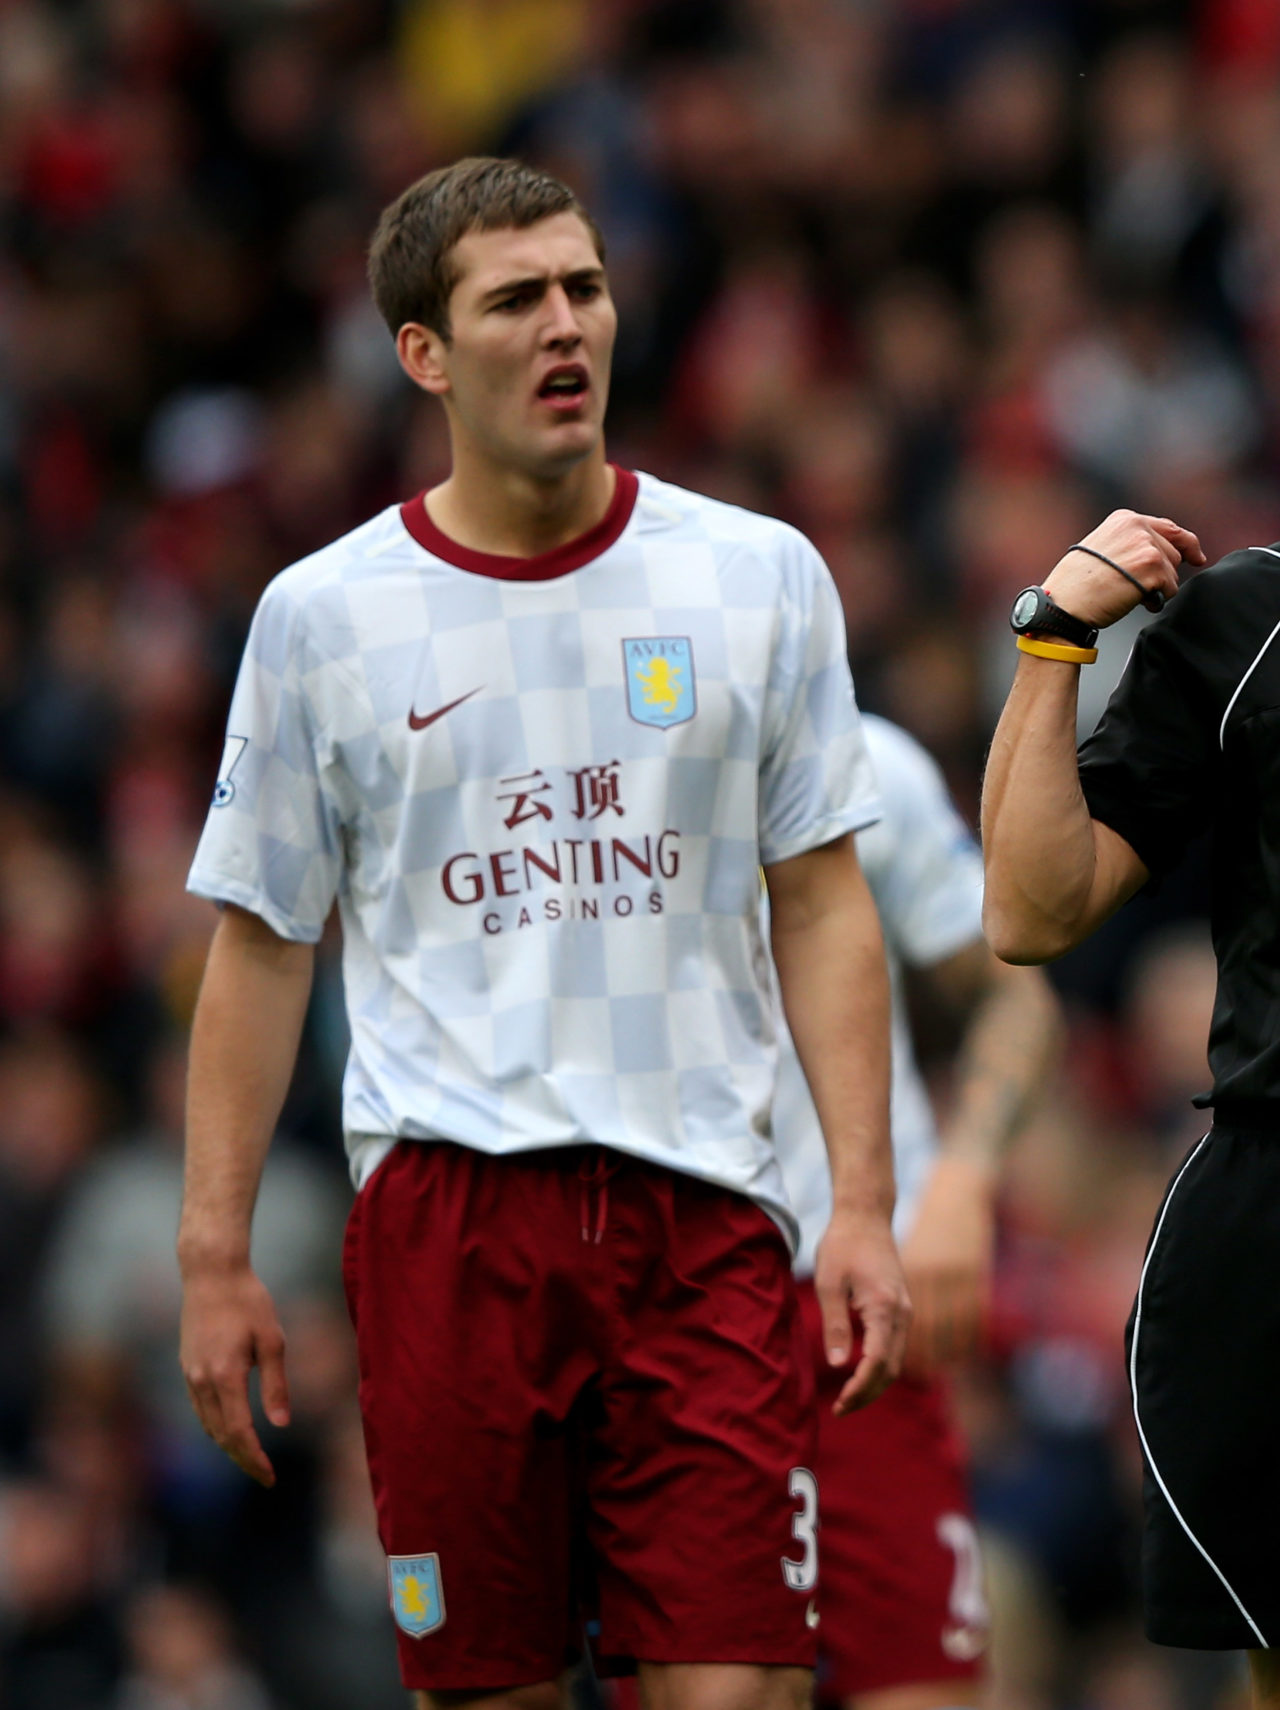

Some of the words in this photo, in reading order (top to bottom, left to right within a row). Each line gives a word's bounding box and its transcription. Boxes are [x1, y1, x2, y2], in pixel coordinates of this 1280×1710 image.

[630, 641, 687, 657] AVFC
[496, 759, 626, 831] 云顶
[441, 829, 681, 906] GENTING
[482, 891, 664, 936] CASINOS
[780, 1466, 819, 1592] 3
